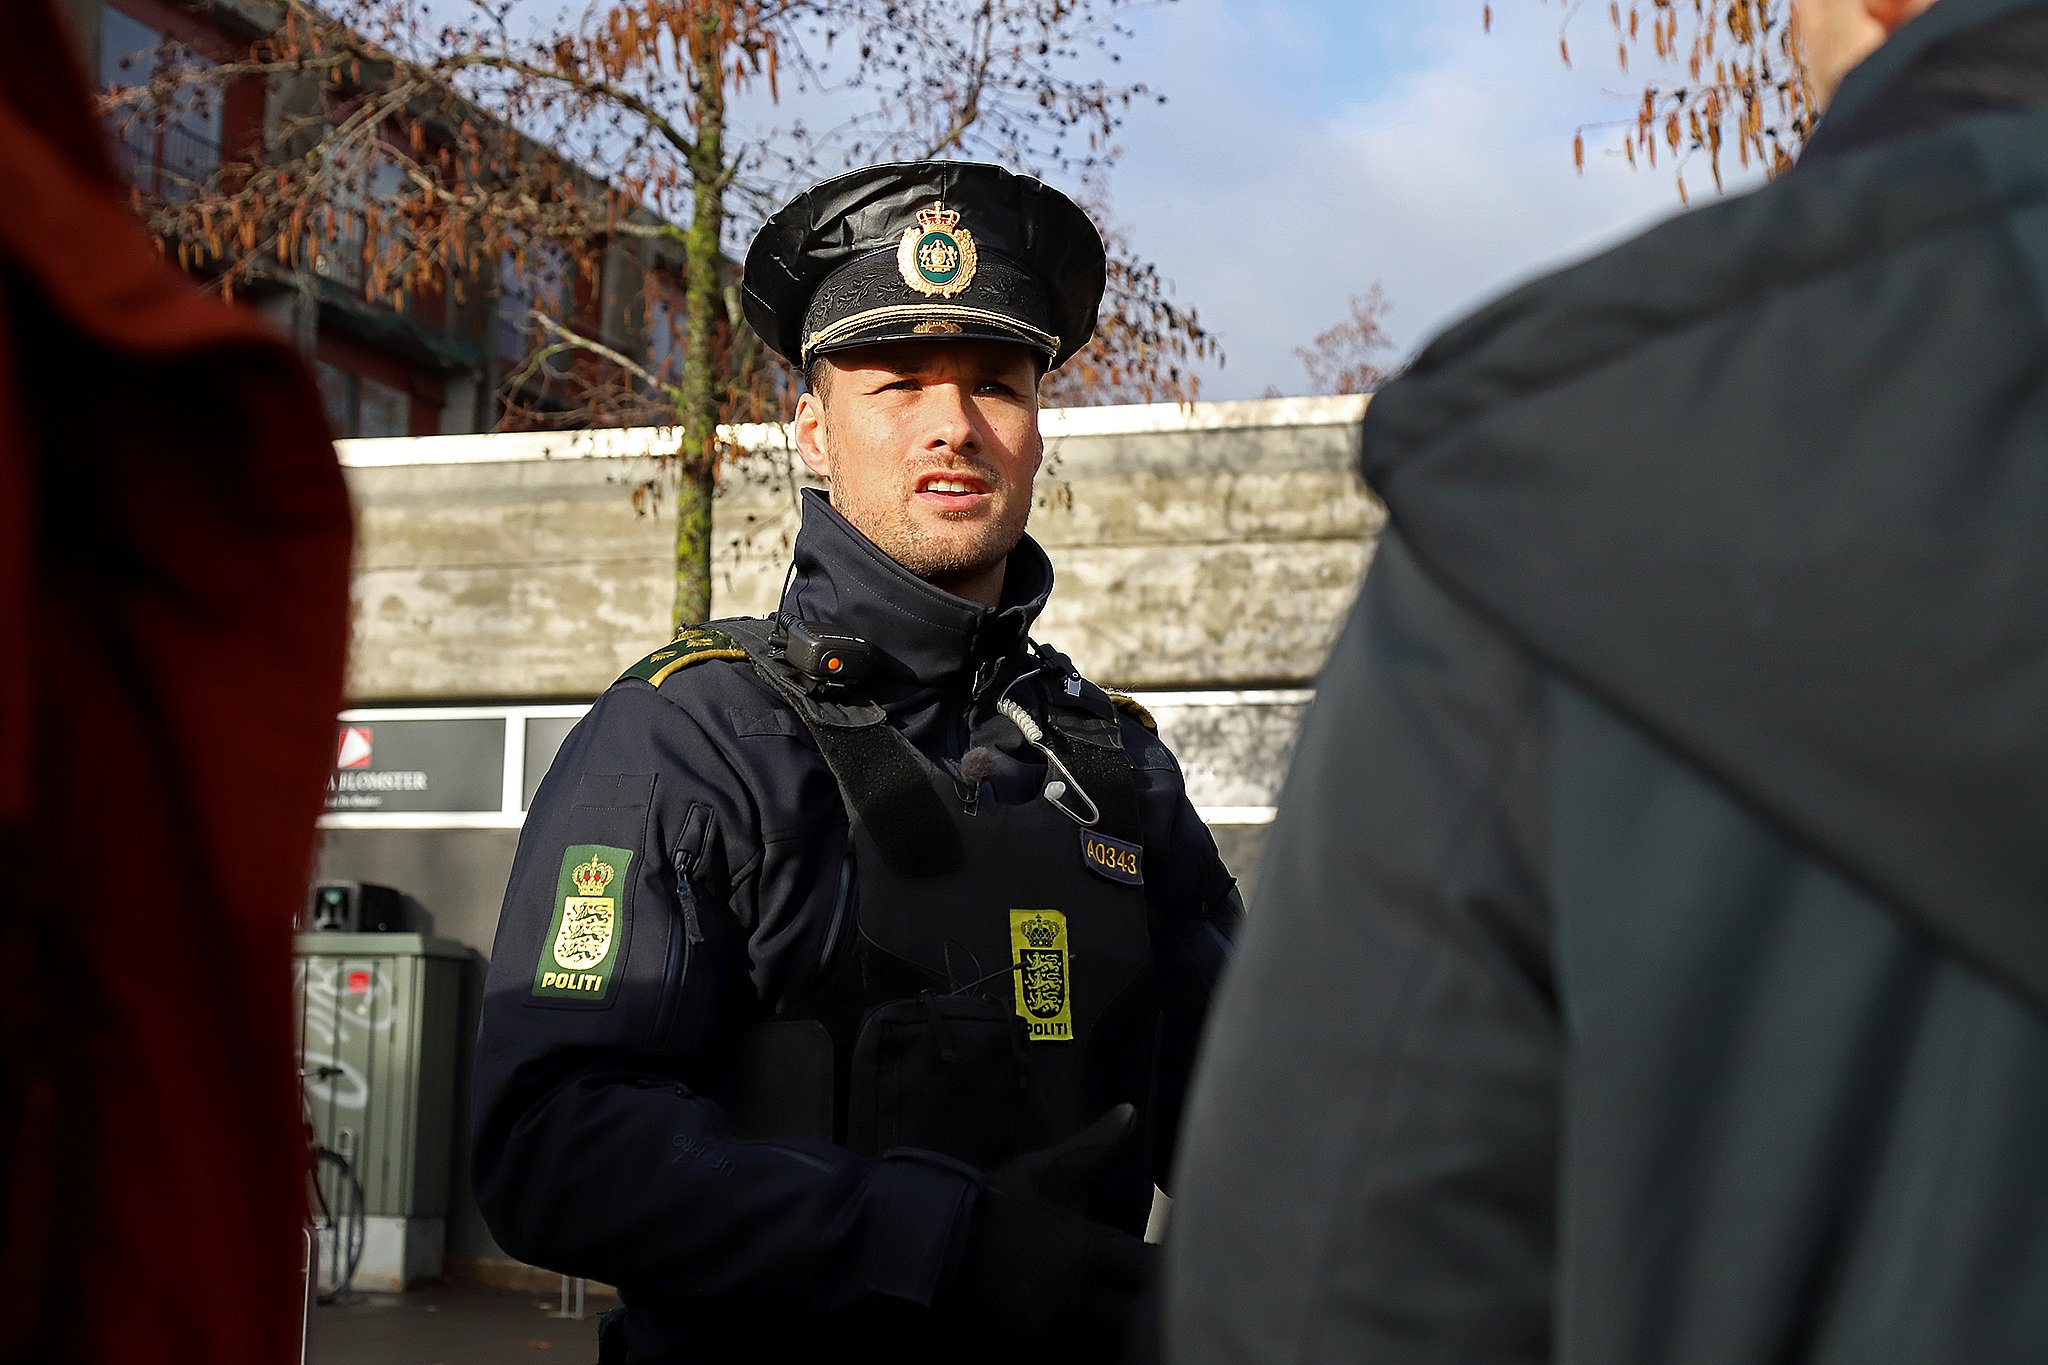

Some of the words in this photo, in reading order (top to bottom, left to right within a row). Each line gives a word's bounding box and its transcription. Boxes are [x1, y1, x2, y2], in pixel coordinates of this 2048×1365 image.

[339, 771, 428, 791] BLOMSTER
[1086, 839, 1137, 875] A0343
[541, 971, 603, 992] POLITI
